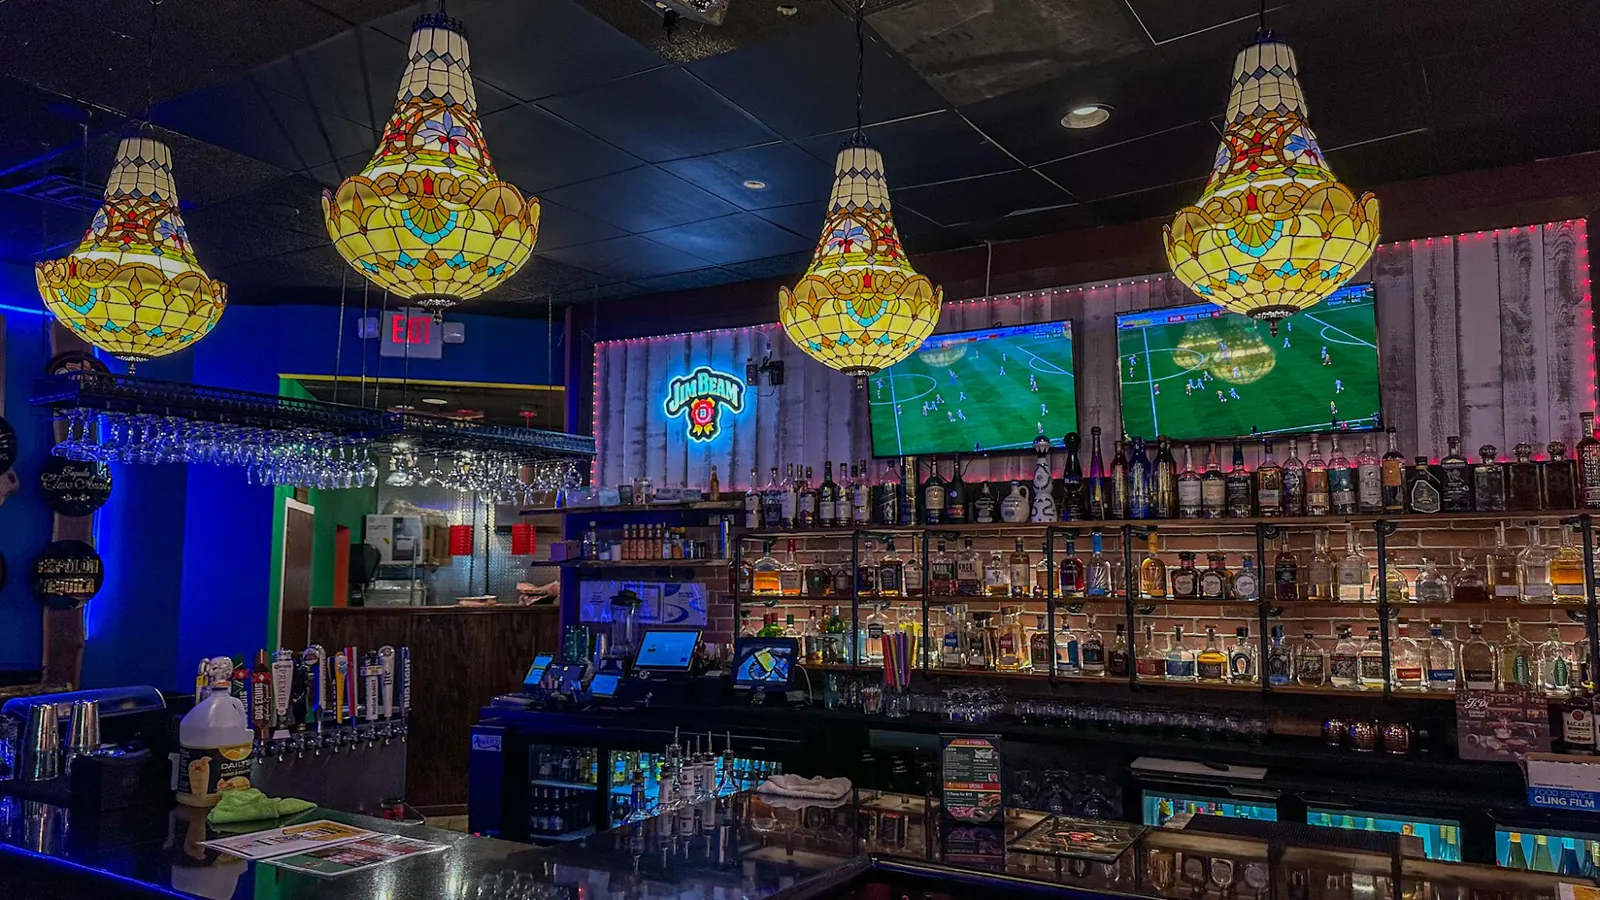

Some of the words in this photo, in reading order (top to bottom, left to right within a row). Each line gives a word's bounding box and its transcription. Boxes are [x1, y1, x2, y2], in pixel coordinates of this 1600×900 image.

[392, 314, 433, 345] EXIT
[669, 380, 698, 412] JIM
[698, 373, 739, 407] BEAM
[255, 682, 263, 704] EQUIS
[278, 669, 286, 710] PREMIER
[255, 704, 263, 720] DOS
[1534, 788, 1559, 797] FOOD
[1560, 790, 1594, 799] SERVICE
[1534, 795, 1567, 806] CLING
[1569, 798, 1595, 808] FILM
